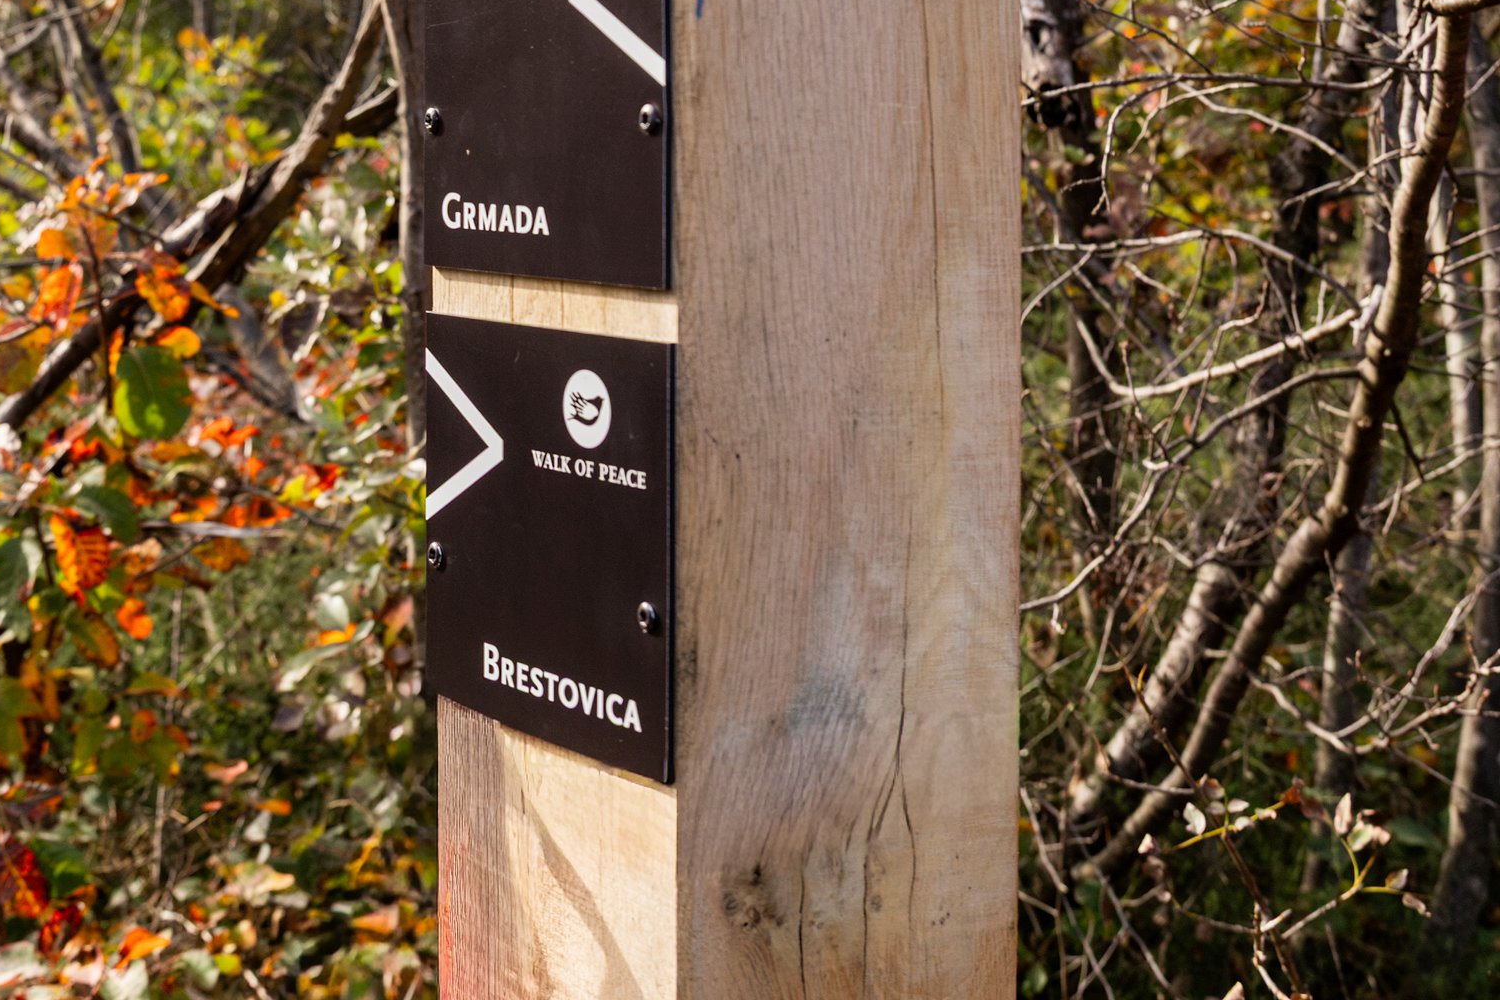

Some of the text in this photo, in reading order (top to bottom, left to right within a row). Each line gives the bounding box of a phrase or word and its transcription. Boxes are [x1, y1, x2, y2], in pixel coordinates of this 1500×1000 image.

[531, 449, 648, 490] WALK OF PEACE
